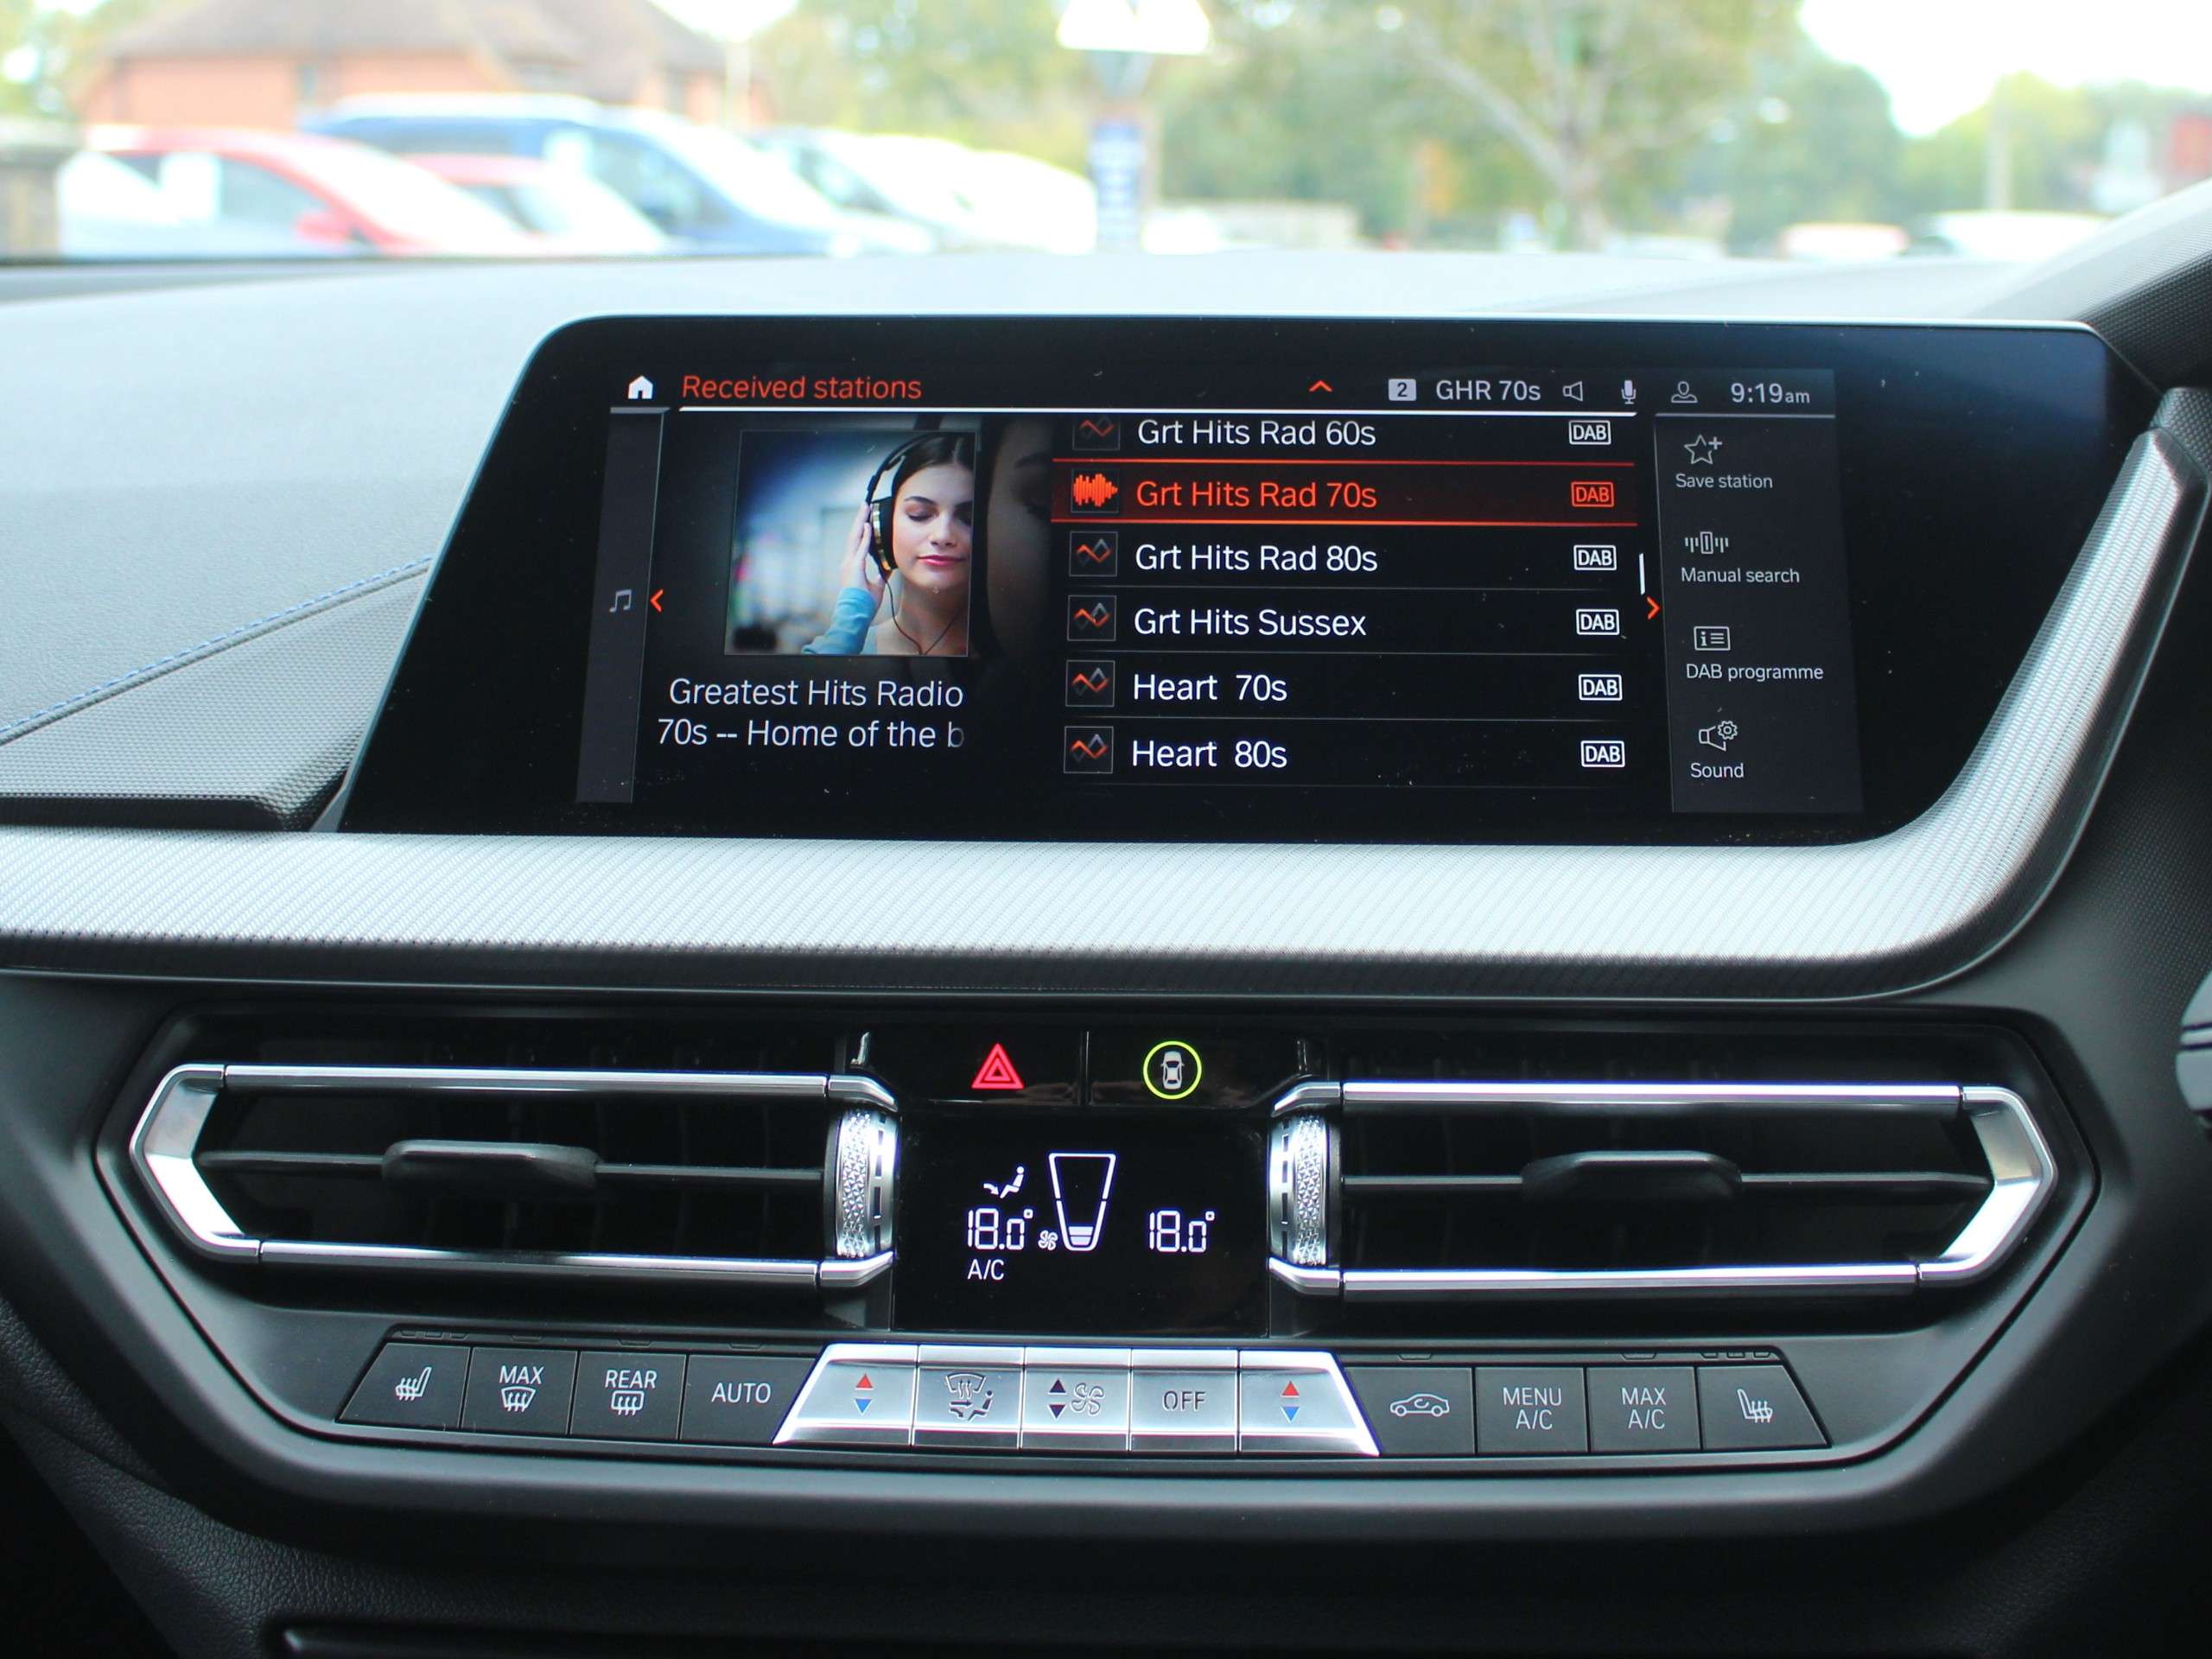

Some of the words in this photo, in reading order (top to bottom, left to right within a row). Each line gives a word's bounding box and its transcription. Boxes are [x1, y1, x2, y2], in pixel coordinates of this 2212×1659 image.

[683, 375, 805, 398] Received
[815, 377, 921, 398] stations
[1436, 380, 1491, 400] GHR
[1499, 380, 1541, 400] 70s
[1139, 420, 1183, 444] Grt
[1193, 420, 1249, 444] Hits
[1262, 421, 1315, 445] Rad
[1326, 421, 1376, 445] 60s
[1573, 424, 1606, 441] DAB
[1676, 474, 1713, 487] Save
[1719, 474, 1772, 488] station
[1137, 480, 1182, 506] Grt
[1192, 482, 1249, 506] Hits
[1261, 482, 1316, 507] Rad
[1327, 482, 1376, 507] 70s
[1575, 486, 1609, 504] DAB
[1136, 544, 1181, 569] Grt
[1192, 544, 1249, 570] Hits
[1261, 545, 1316, 570] Rad
[1326, 545, 1377, 571] 80s
[1577, 549, 1611, 567] DAB
[1681, 568, 1740, 582] Manual
[1746, 569, 1799, 582] search
[1135, 608, 1180, 634] Grt
[1191, 609, 1249, 635] Hits
[1259, 609, 1366, 636] Sussex
[1580, 613, 1615, 631] DAB
[1687, 664, 1722, 678] DAB
[1728, 667, 1823, 682] programme
[671, 678, 798, 705] Greatest
[809, 680, 866, 706] Hits
[878, 681, 963, 707] Radio
[1135, 674, 1217, 700] Heart
[1236, 675, 1287, 701] 70s
[1582, 678, 1618, 697] DAB
[658, 719, 707, 745] 70s
[748, 720, 837, 747] Home
[849, 721, 879, 747] of
[887, 721, 936, 747] the
[1133, 741, 1217, 766] Heart
[1235, 741, 1287, 767] 80s
[1584, 746, 1621, 763] DAB
[1691, 763, 1744, 778] Sound
[968, 1259, 1004, 1280] A/C
[499, 1366, 543, 1384] MAX
[606, 1370, 657, 1389] REAR
[712, 1382, 771, 1403] AUTO
[1162, 1389, 1206, 1412] OFF
[1503, 1388, 1561, 1406] MENU
[1622, 1388, 1666, 1405] MAX
[1516, 1409, 1552, 1429] A/C
[1629, 1409, 1664, 1429] A/C
